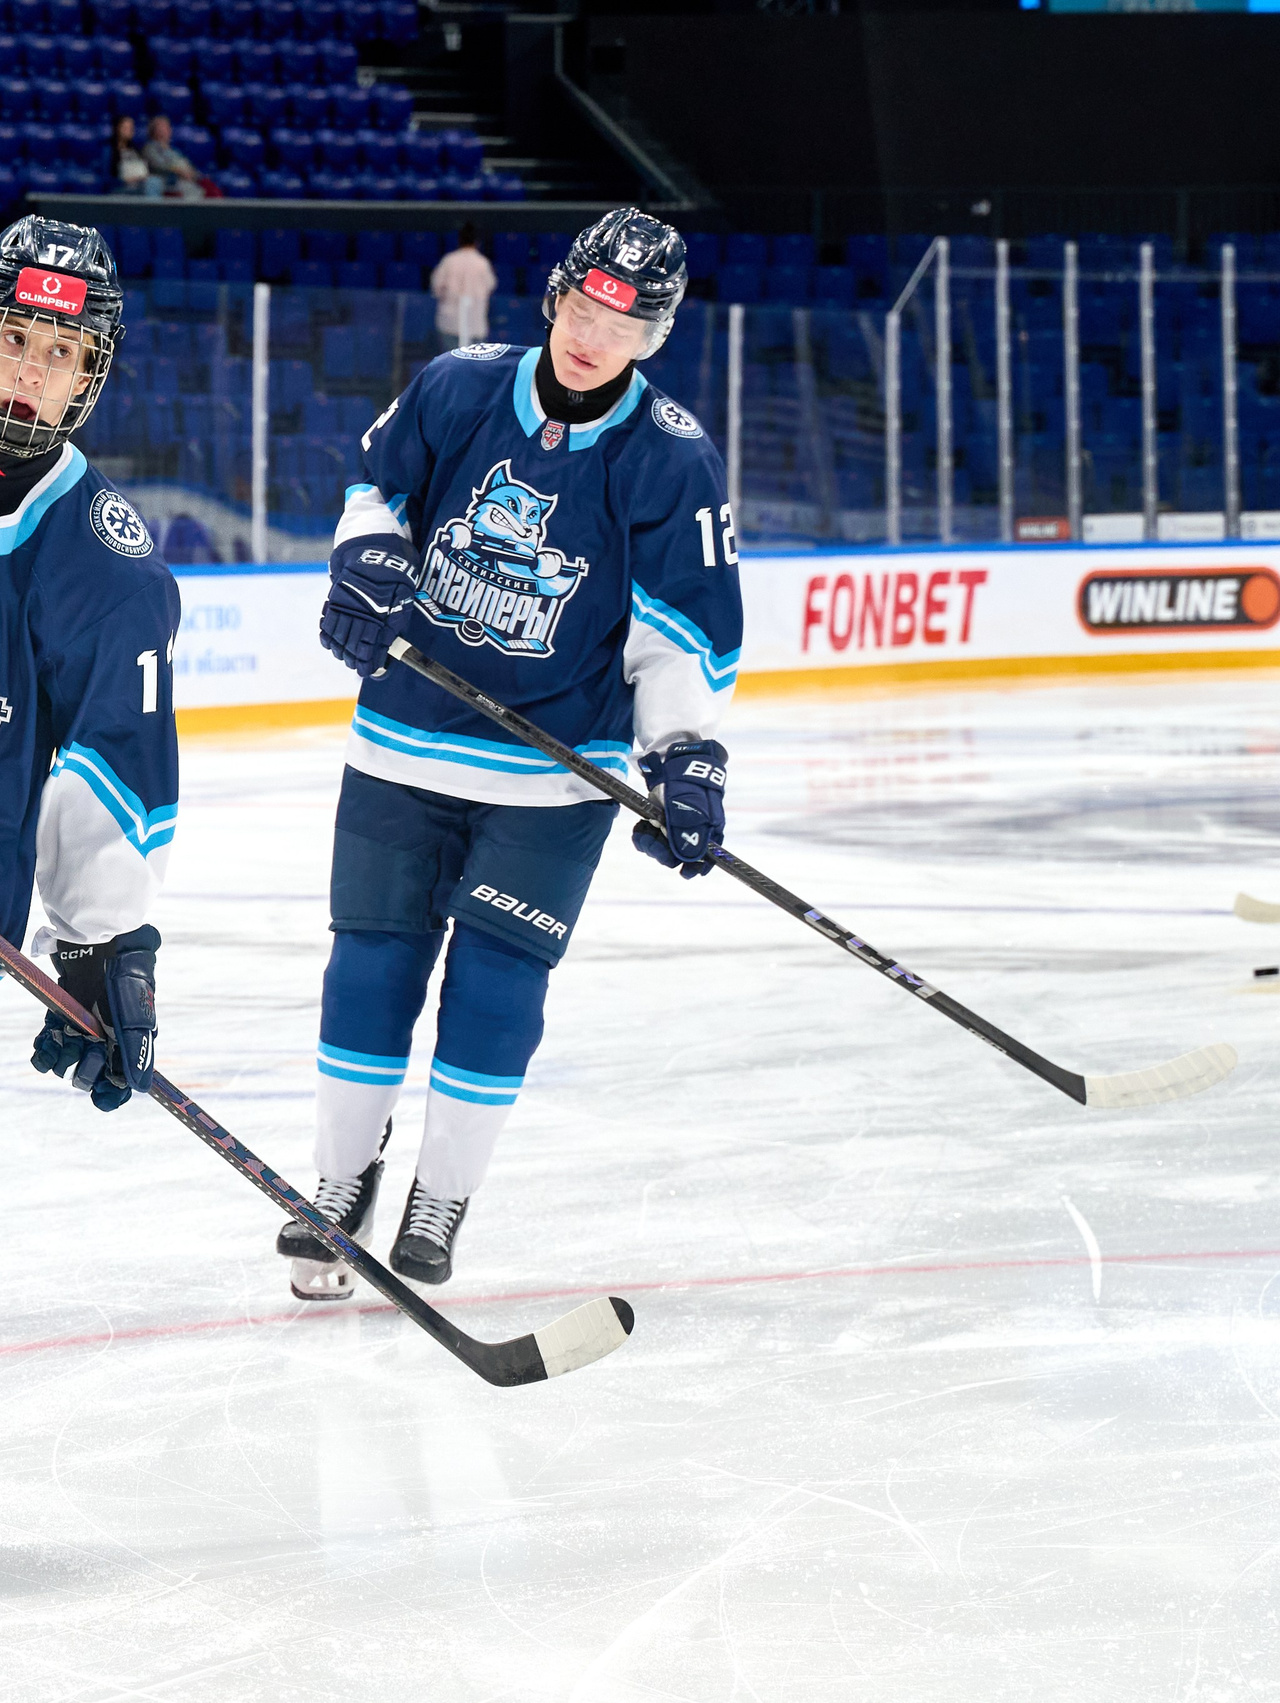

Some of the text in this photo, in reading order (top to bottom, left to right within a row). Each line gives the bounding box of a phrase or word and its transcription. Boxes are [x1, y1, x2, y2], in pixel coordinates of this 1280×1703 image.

[47, 243, 75, 267] 17
[615, 247, 641, 271] 12
[19, 291, 78, 311] OLIMPBET
[585, 285, 627, 309] OLIMPBET
[457, 555, 531, 592] СИБИРСКИЕ
[801, 570, 989, 654] FONBET
[1087, 577, 1238, 625] WINLINE
[136, 629, 176, 714] 1
[470, 884, 569, 941] BAUER
[60, 946, 94, 961] CCM
[137, 1035, 149, 1071] CCM
